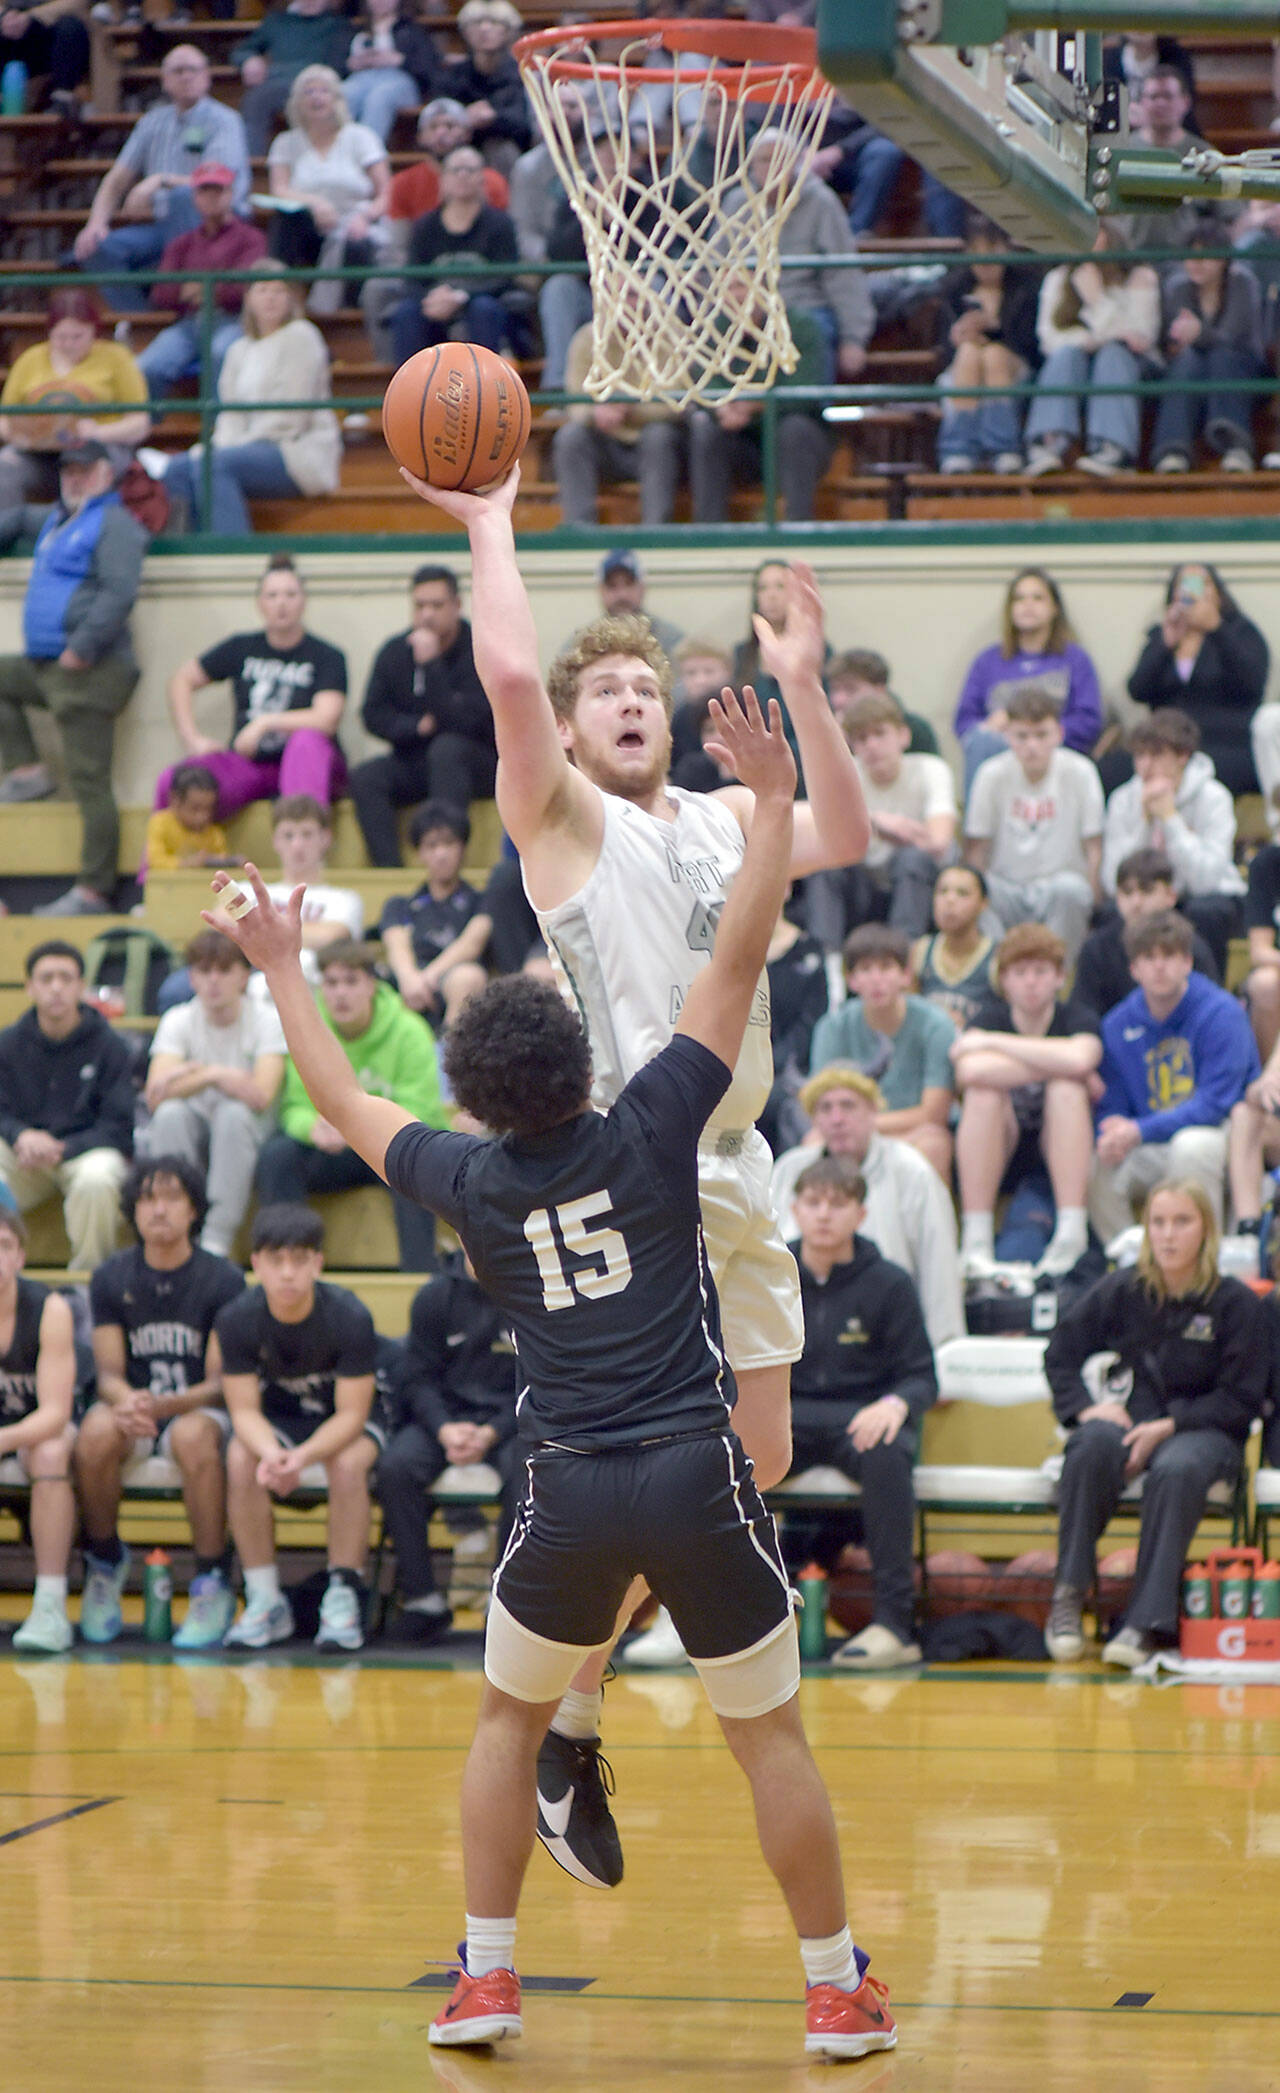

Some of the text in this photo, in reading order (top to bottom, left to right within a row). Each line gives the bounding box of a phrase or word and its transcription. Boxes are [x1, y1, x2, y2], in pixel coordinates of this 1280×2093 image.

[433, 367, 465, 466] Baden
[686, 900, 727, 961] 4
[523, 1189, 633, 1312] 15
[128, 1322, 201, 1357] NORTH
[1217, 1626, 1246, 1658] G
